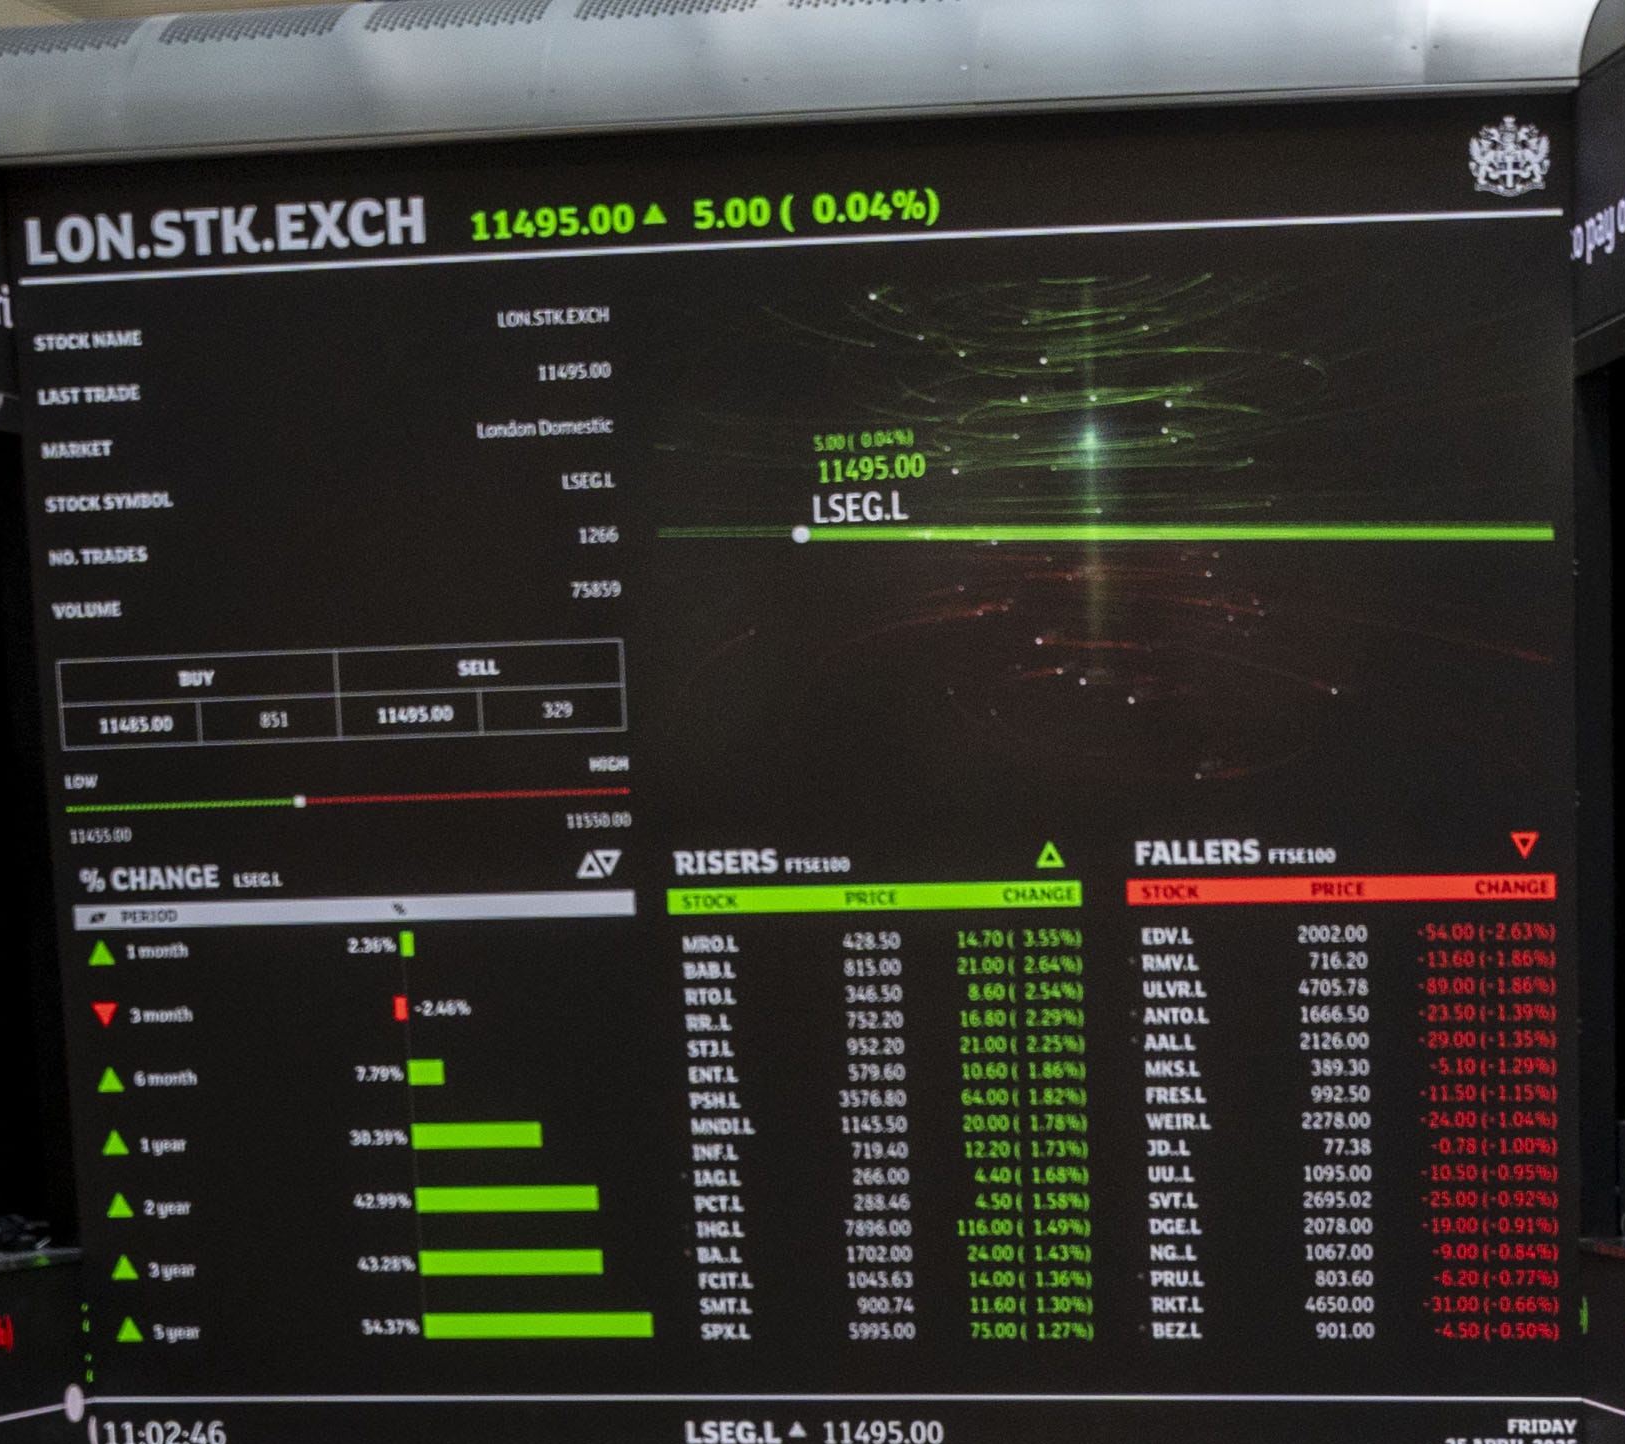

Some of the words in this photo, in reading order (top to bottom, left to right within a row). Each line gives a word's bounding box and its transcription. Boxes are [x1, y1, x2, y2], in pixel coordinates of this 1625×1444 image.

[25, 196, 426, 266] LON.STK.EXCH
[470, 203, 635, 241] 11495.00
[693, 196, 772, 230] 5.00
[1584, 205, 1616, 265] pay
[496, 306, 610, 329] LON.STK.EXCH
[33, 332, 91, 352] STOCK
[91, 329, 143, 348] NAME
[538, 361, 612, 382] 11495.00
[37, 386, 82, 406] LAST
[82, 383, 141, 403] TRADE
[476, 420, 537, 440] London
[537, 418, 614, 437] Domestic
[41, 439, 113, 459] MARKET
[818, 452, 927, 484] 11495.00
[561, 471, 616, 491] LSEG.L
[44, 494, 102, 514] STOCK
[102, 491, 174, 511] SYMBOL
[812, 490, 910, 524] LSEG.L
[48, 548, 79, 566] NO.
[79, 545, 149, 565] TRADES
[51, 600, 122, 620] VOLUME
[177, 669, 215, 688] BUY
[457, 659, 500, 677] SELL
[64, 774, 99, 790] LOW
[588, 755, 630, 772] HIGH
[673, 848, 779, 876] RISERS
[784, 856, 851, 874] FTSE100
[1135, 838, 1261, 866] FALLERS
[1267, 847, 1337, 865] FTSE100
[78, 868, 107, 893] %
[110, 864, 220, 892] CHANGE
[232, 871, 283, 888] LSEG.L
[1141, 884, 1198, 899] STOCK
[1311, 882, 1365, 897] PRICE
[1476, 879, 1549, 895] CHANGE
[682, 894, 738, 910] STOCK
[844, 890, 899, 905] PRICE
[1003, 887, 1075, 902] CHANGE
[121, 909, 178, 924] PERIOD
[1141, 926, 1194, 946] EDV.L
[1297, 924, 1369, 944] 2002.00
[682, 961, 737, 980] BAB.L
[843, 957, 903, 977] 815.00
[957, 956, 1006, 976] 21.00
[1142, 980, 1207, 999] ULVR.L
[1297, 977, 1370, 997] 4705.78
[129, 1007, 143, 1024] 3
[142, 1006, 194, 1023] month
[146, 1069, 198, 1087] month
[354, 1065, 405, 1082] 7.79%
[690, 1117, 756, 1136] MNDI.L
[841, 1114, 908, 1134] 1145.50
[698, 1271, 754, 1290] FCIT.L
[847, 1270, 914, 1289] 1045.63
[969, 1270, 1016, 1288] 14.00
[165, 1326, 201, 1344] year
[1151, 1321, 1203, 1339] BEZ.L
[1315, 1321, 1376, 1340] 901.00
[1507, 1418, 1578, 1435] FRIDAY
